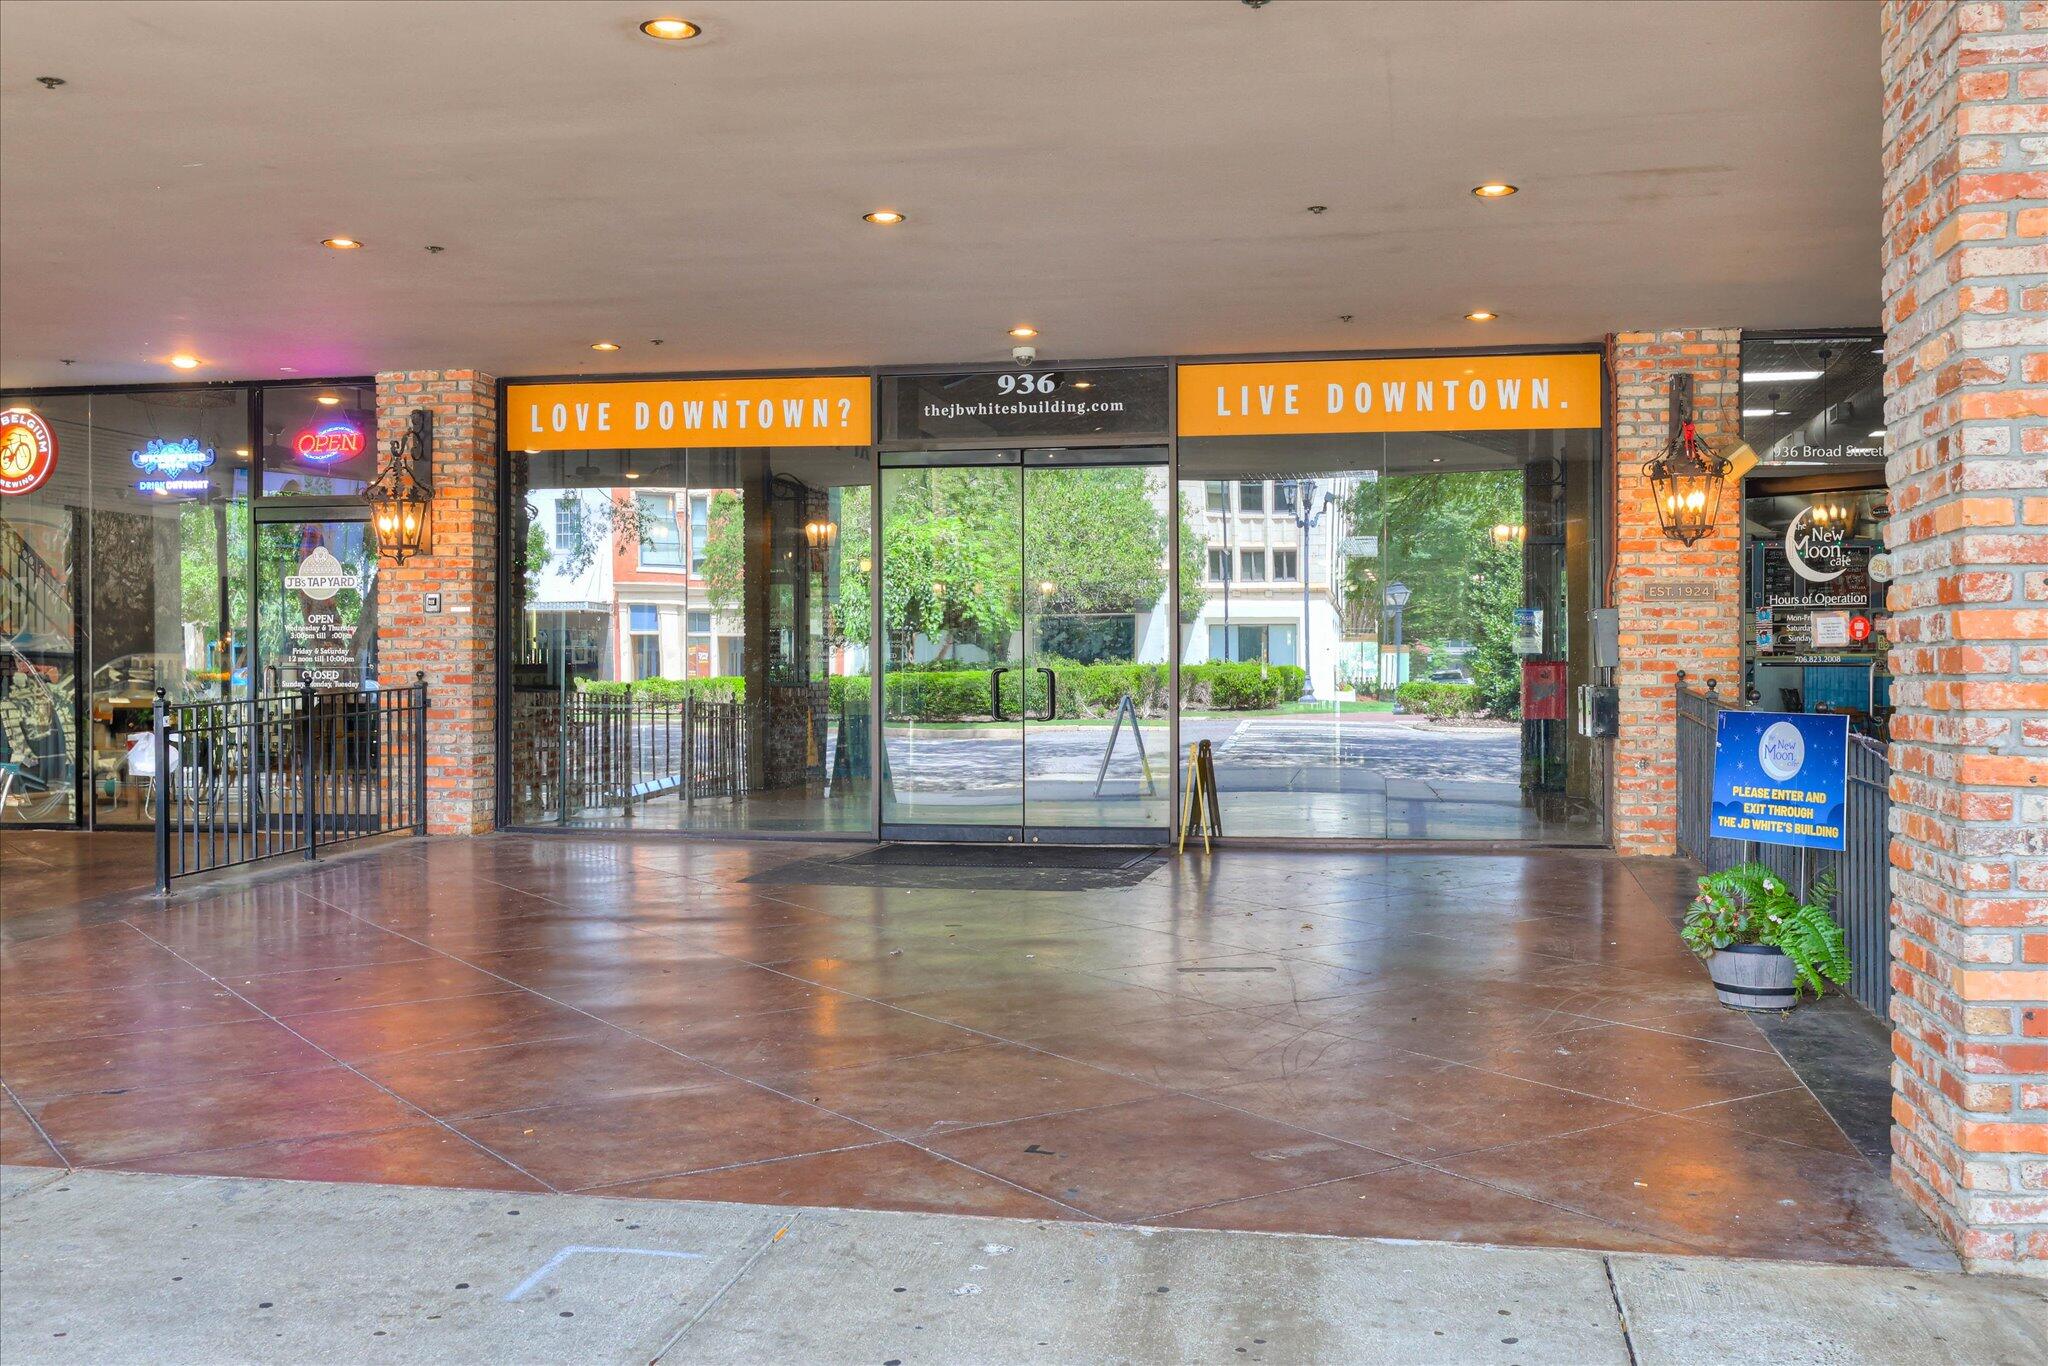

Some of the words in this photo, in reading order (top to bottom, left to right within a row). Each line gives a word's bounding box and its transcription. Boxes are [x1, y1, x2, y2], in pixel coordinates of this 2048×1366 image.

[997, 373, 1056, 395] 936
[1217, 384, 1299, 416] LIVE
[1328, 378, 1568, 414] DOWNTOWN.
[530, 402, 610, 433] LOVE
[635, 398, 851, 430] DOWNTOWN?
[924, 400, 1124, 419] thejbwhitesbuilding.com
[1, 414, 48, 453] BELGIUM
[299, 433, 358, 452] OPEN
[1773, 446, 1798, 458] 936
[1803, 445, 1841, 457] Broad
[1846, 445, 1883, 457] Street
[0, 473, 35, 488] REWING
[1812, 527, 1844, 542] New
[1793, 535, 1841, 559] Moon
[307, 577, 327, 588] TAP
[328, 577, 356, 588] YARD
[1649, 586, 1674, 597] EST.
[1678, 586, 1710, 597] 1924
[1769, 594, 1799, 605] Hours
[1801, 594, 1812, 604] of
[1815, 593, 1867, 607] Operation
[308, 614, 334, 624] OPEN
[284, 625, 320, 633] Wednesday
[328, 625, 358, 633] Thursday
[292, 648, 312, 656] Friday
[320, 648, 349, 656] Saturday
[326, 656, 354, 664] 10:00pm
[302, 670, 340, 680] CLOSED
[1764, 744, 1794, 760] Moon
[1778, 739, 1796, 750] New
[1732, 786, 1770, 799] PLEASE
[1772, 789, 1804, 801] ENTER
[1805, 792, 1827, 804] AND
[1743, 803, 1766, 815] EXIT
[1768, 804, 1814, 819] THROUGH
[1718, 816, 1736, 827] THE
[1737, 818, 1751, 829] JB
[1752, 819, 1793, 833] WHITE'S
[1794, 824, 1839, 838] BUILDING
